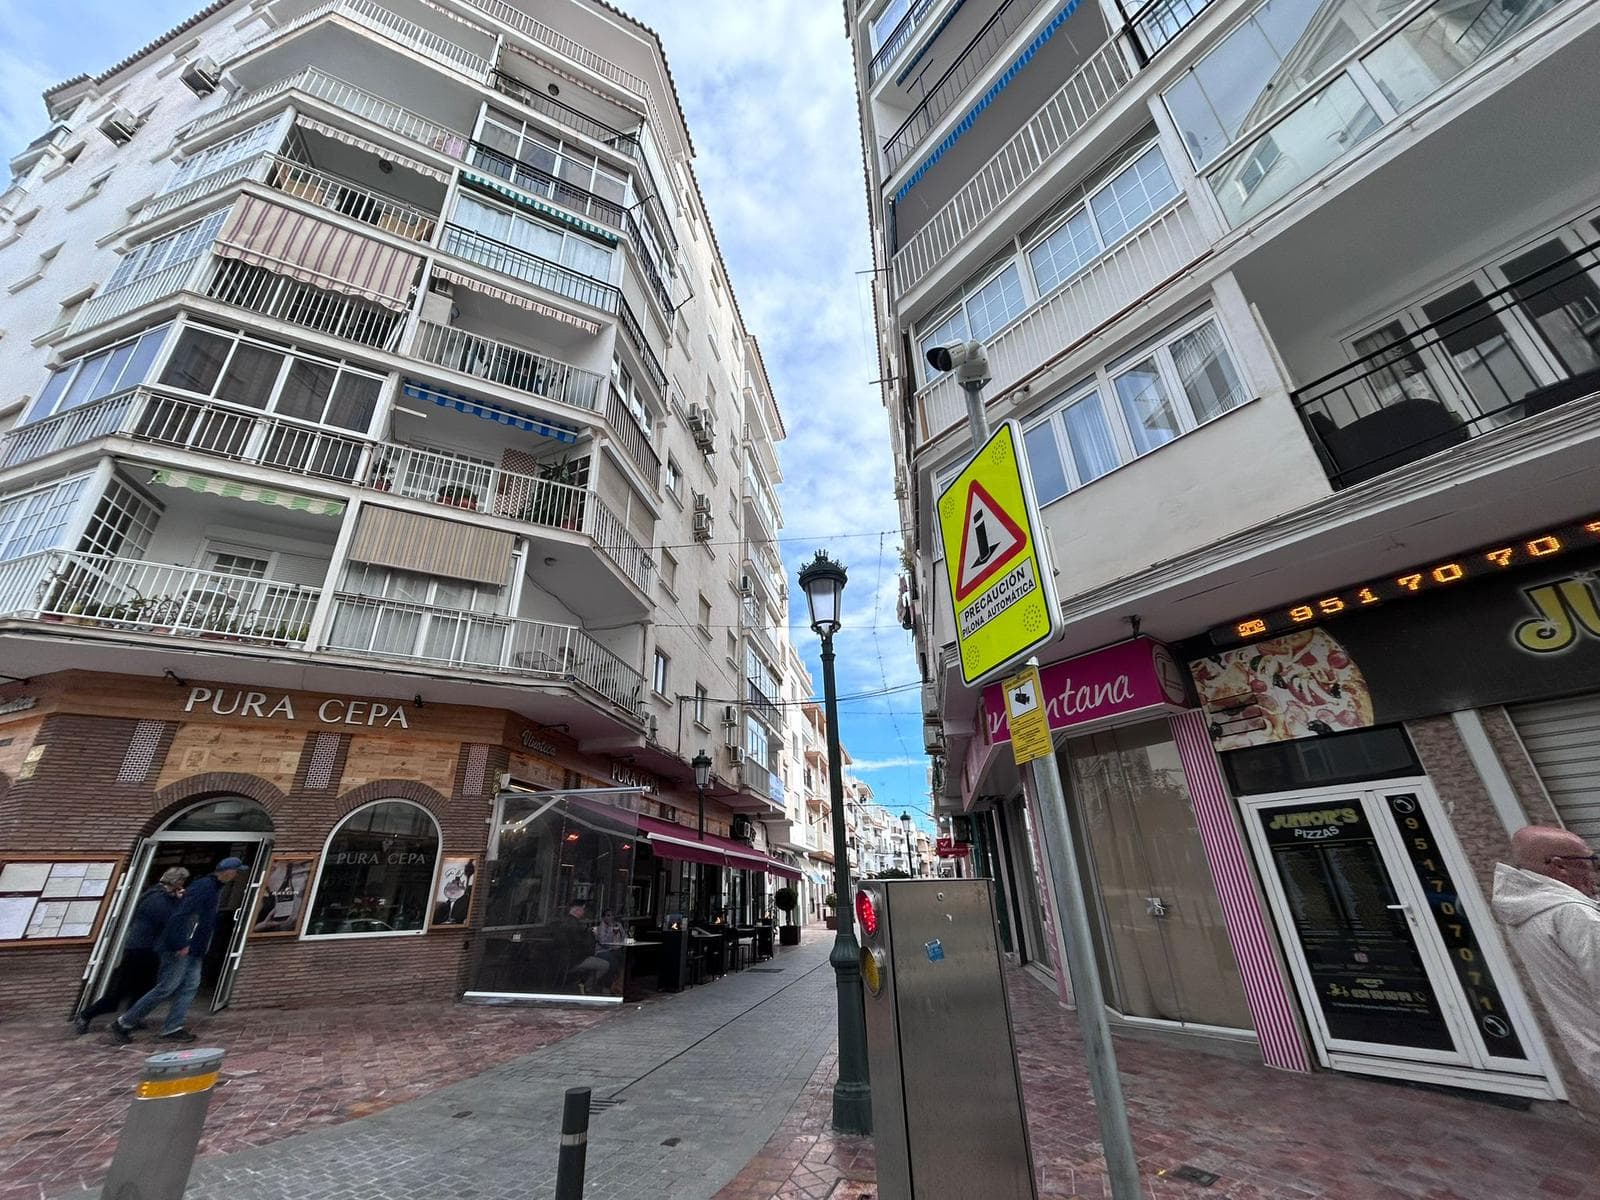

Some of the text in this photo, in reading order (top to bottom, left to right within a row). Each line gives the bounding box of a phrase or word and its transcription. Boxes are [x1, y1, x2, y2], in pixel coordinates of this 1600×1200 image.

[964, 566, 1026, 622] PRECAUCIÓN
[1289, 535, 1562, 624] 951 70 70
[962, 578, 1035, 637] PILONA AUTOMÁTICA
[183, 686, 410, 730] PURA CEPA
[611, 761, 638, 789] PURA
[1269, 807, 1360, 831] JUNIOR'S
[1293, 825, 1340, 839] PIZZAS
[336, 852, 426, 865] PURA CEPA
